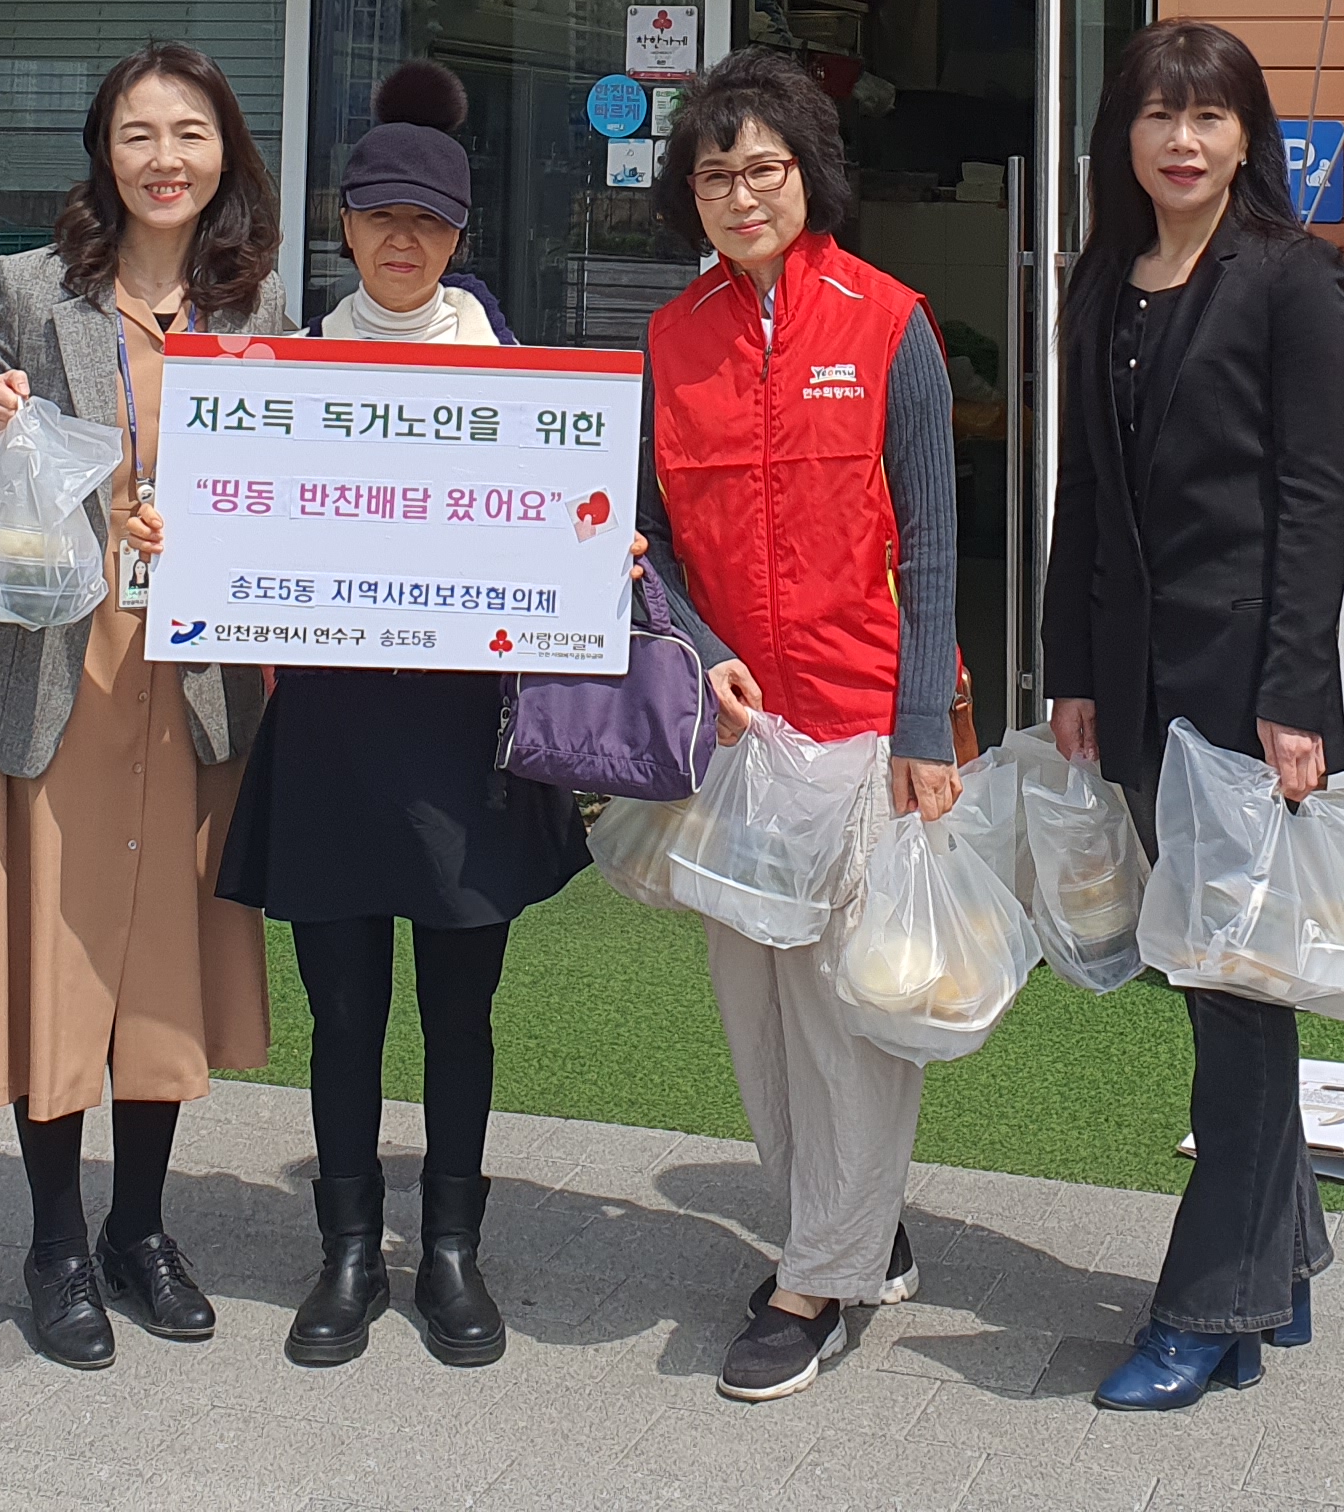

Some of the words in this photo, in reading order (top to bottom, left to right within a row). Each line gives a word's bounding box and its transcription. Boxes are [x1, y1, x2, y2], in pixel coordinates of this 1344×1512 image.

[594, 83, 641, 103] 한집만
[593, 104, 641, 121] 빠르게
[186, 395, 295, 436] 저소득
[321, 402, 502, 443] 독거노인을
[535, 409, 605, 448] 위한
[298, 482, 431, 521] 반찬배달
[230, 574, 316, 605] 송도5동
[331, 579, 558, 615] 지역사회보장협의체
[213, 624, 308, 645] 인천광역시
[314, 627, 367, 646] 연수구
[379, 629, 438, 649] 송도5동
[517, 631, 605, 651] 사랑의열매
